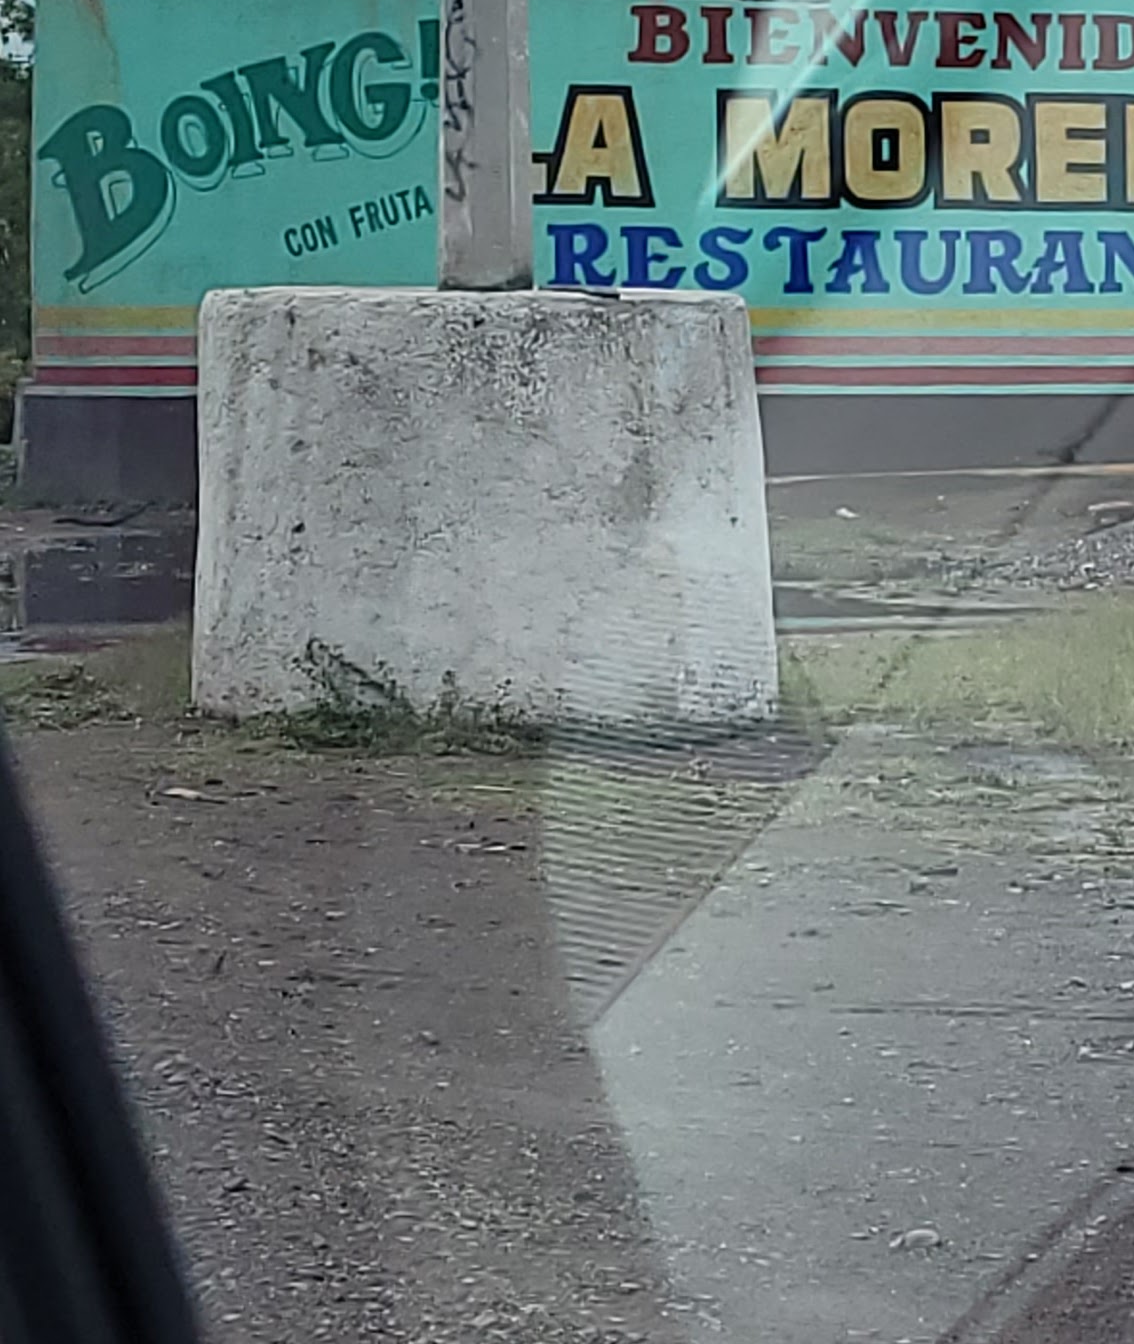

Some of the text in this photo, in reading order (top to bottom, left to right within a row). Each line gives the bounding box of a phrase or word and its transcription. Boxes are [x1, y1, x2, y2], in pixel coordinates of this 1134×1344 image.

[532, 84, 657, 209] A
[283, 184, 434, 258] CON FRUTA
